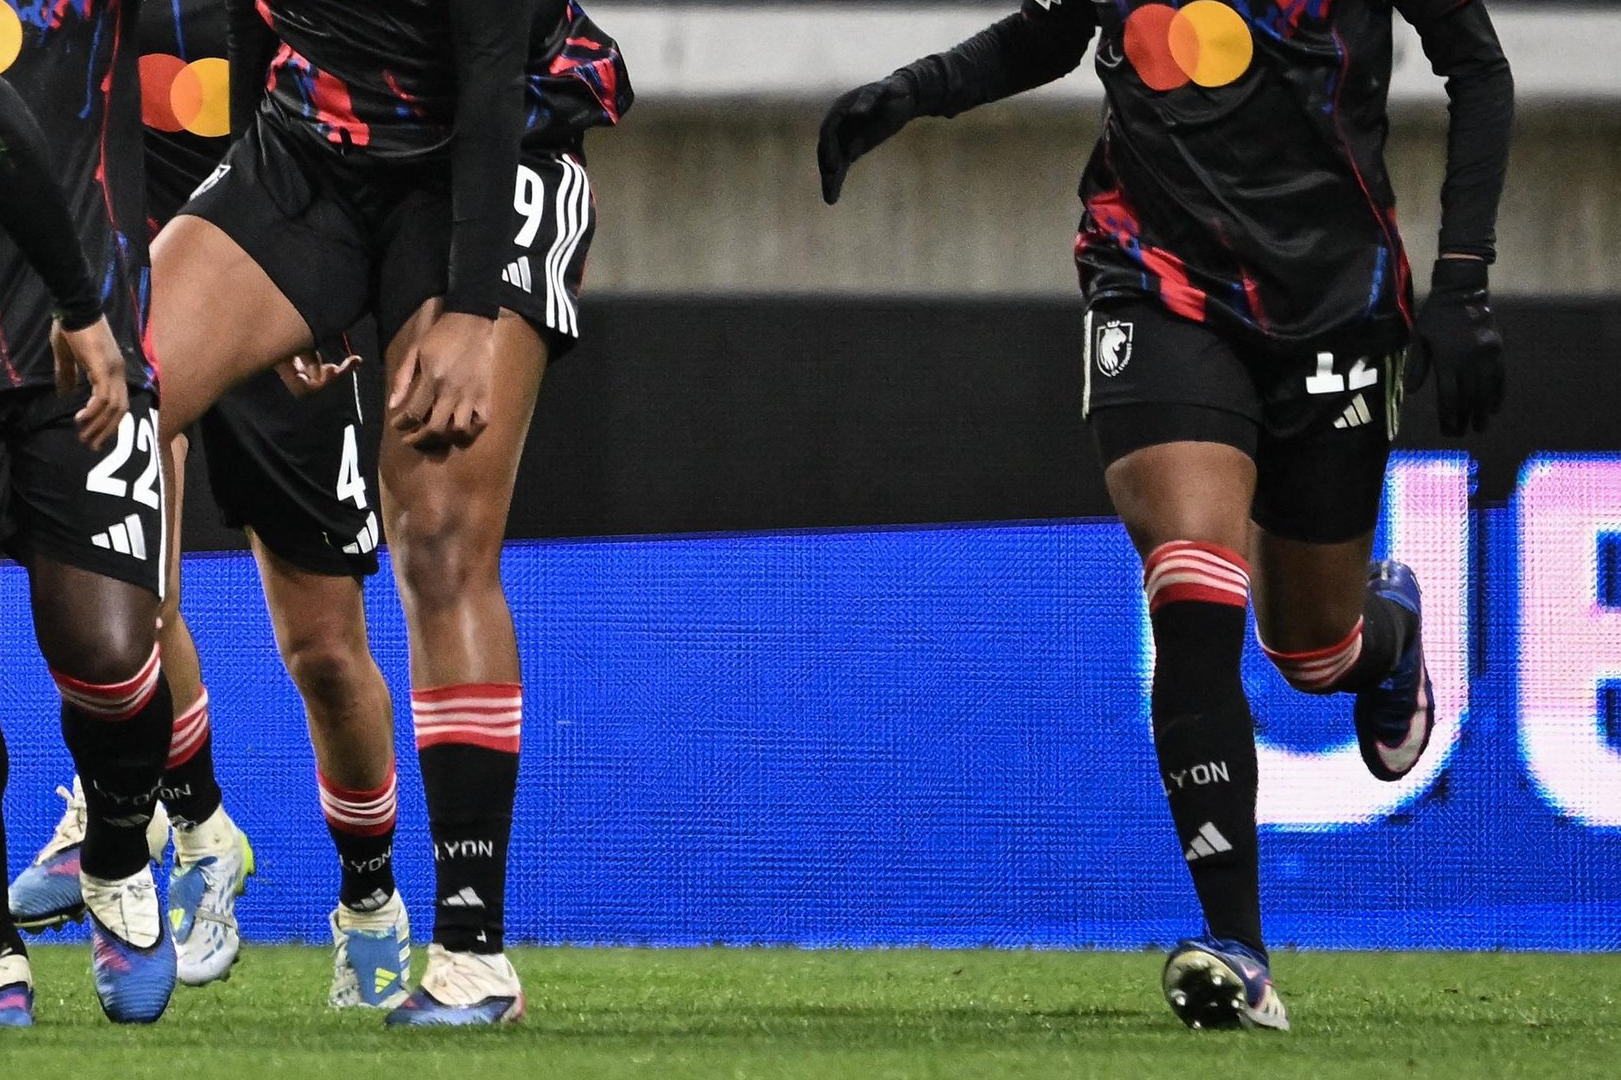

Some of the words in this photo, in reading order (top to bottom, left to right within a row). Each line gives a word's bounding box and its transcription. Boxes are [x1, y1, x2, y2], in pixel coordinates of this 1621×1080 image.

[513, 164, 545, 248] 9
[85, 411, 160, 510] 22
[336, 424, 368, 510] 4
[434, 839, 494, 862] LYON
